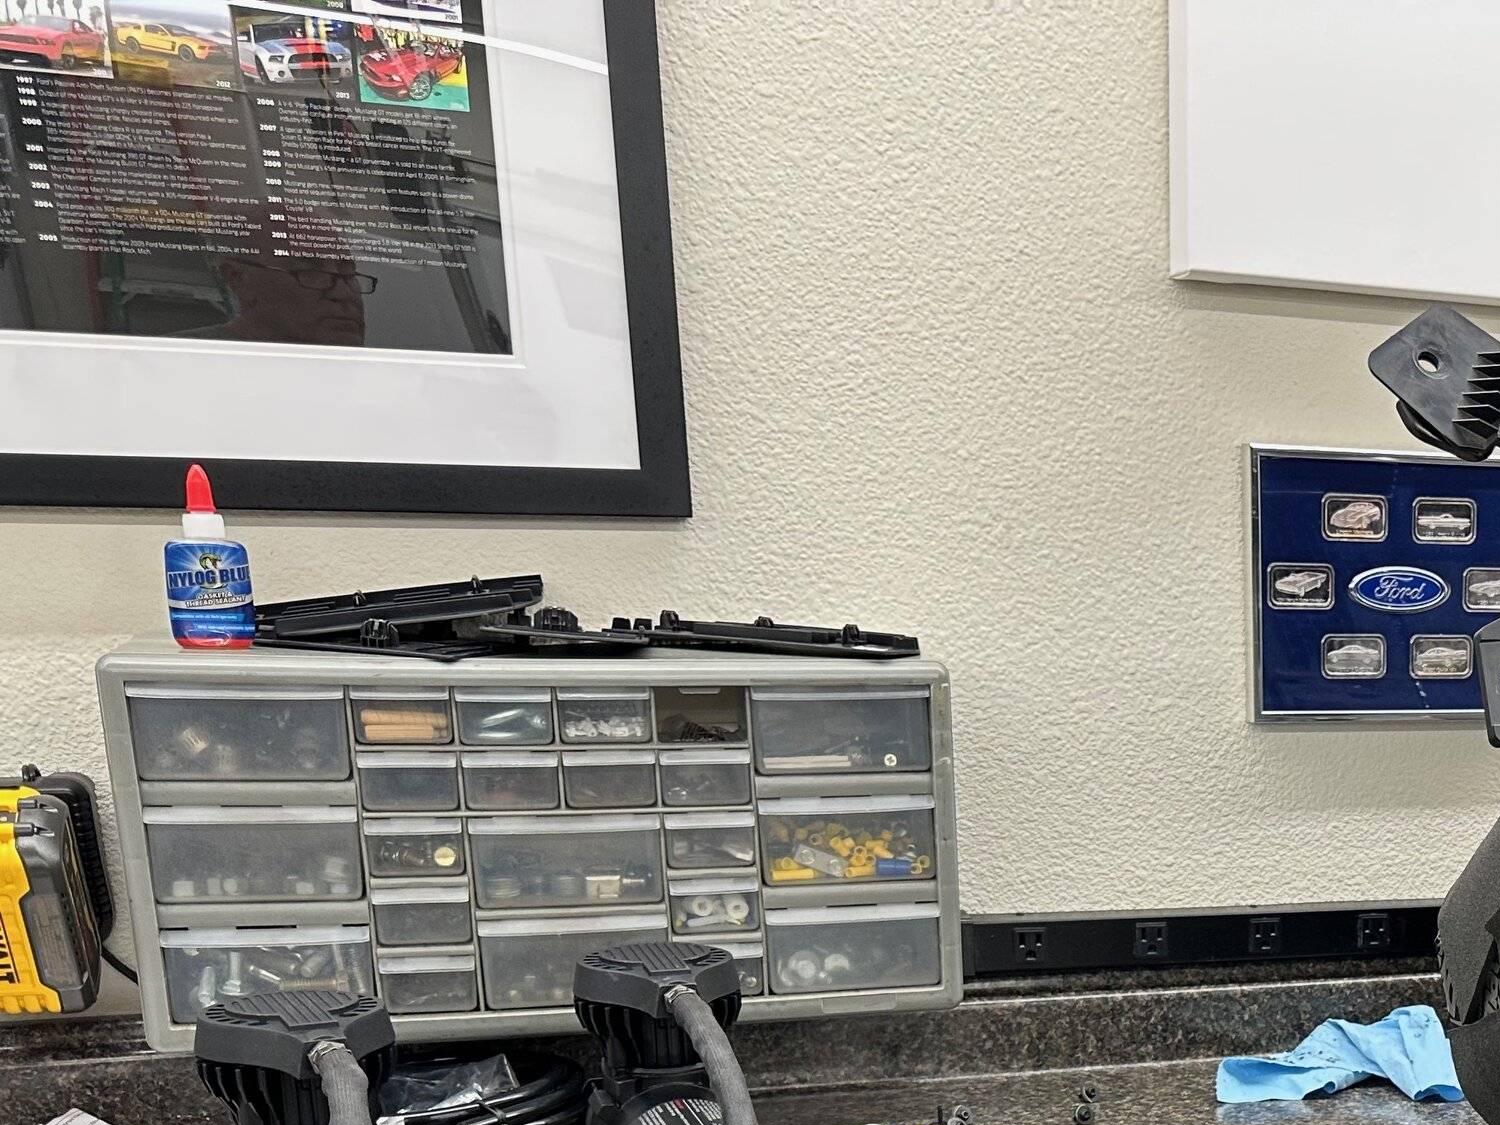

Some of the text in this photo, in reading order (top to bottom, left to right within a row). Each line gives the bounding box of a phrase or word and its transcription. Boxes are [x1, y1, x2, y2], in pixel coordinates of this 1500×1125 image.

[16, 76, 33, 84] 1997
[216, 80, 231, 88] 2012
[18, 88, 36, 96] 1998
[336, 91, 350, 99] 2013
[20, 98, 37, 106] 1999
[256, 98, 274, 106] 2006
[22, 118, 42, 126] 2000
[26, 144, 44, 152] 2001
[32, 182, 50, 190] 2003
[34, 200, 54, 208] 2004
[39, 234, 58, 242] 2005
[168, 570, 217, 588] NYLOG
[1374, 576, 1426, 600] Ford
[185, 596, 246, 608] THREAD SEALANT
